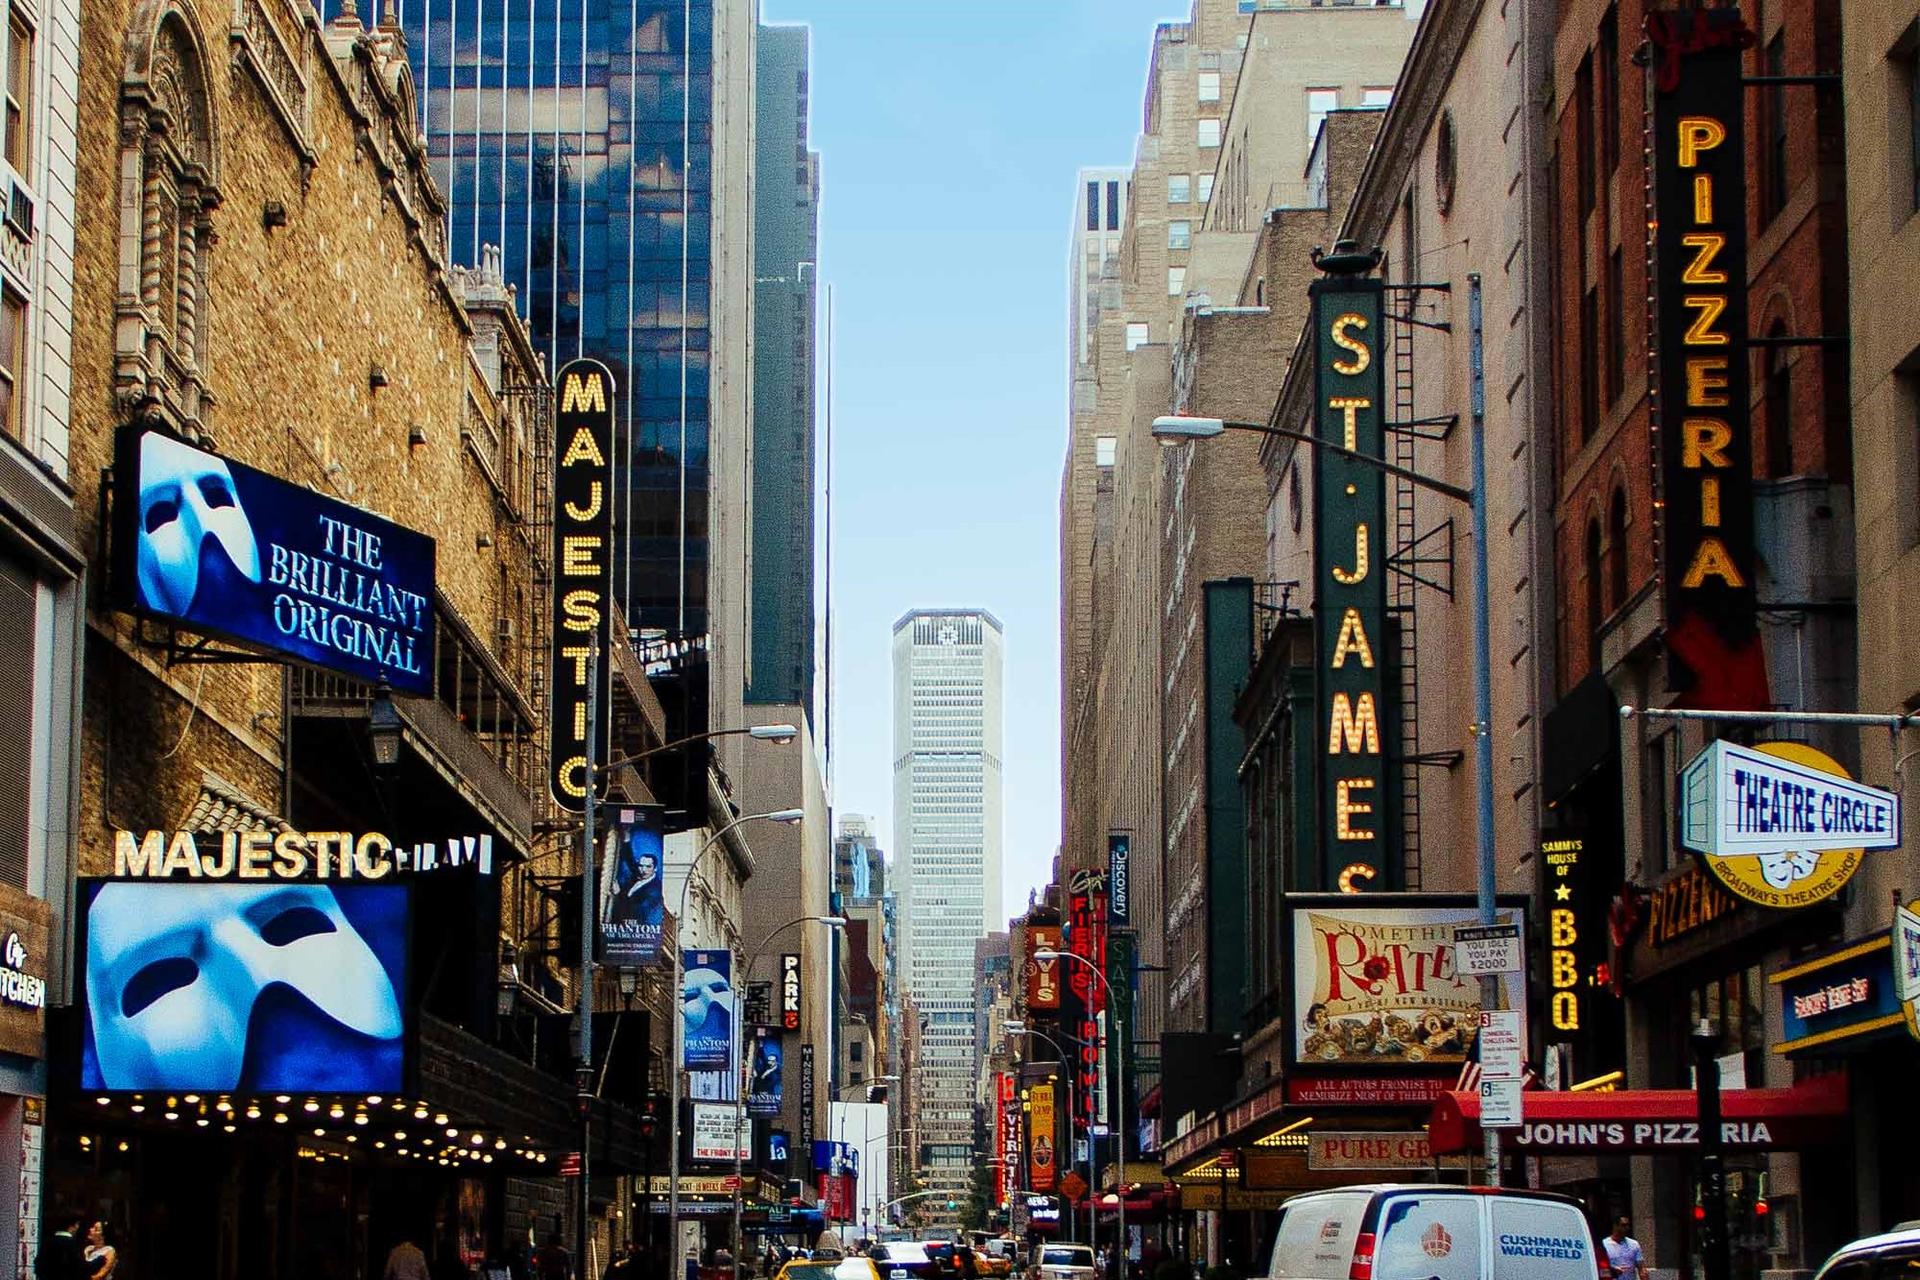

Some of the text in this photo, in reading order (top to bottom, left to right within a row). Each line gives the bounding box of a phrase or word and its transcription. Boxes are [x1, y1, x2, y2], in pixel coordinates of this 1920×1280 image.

[1677, 115, 1746, 590] PIZZERIA
[319, 513, 383, 571] THE
[269, 541, 427, 634] BRILLIANT
[558, 372, 606, 799] MAJESTIC
[273, 591, 422, 675] ORIGINAL
[1733, 768, 1886, 833] THEATRE CIRCLE
[113, 829, 393, 880] MAJESTIC
[1546, 853, 1578, 865] HOUSE
[1556, 865, 1570, 877] OF
[1713, 851, 1858, 906] BROADWAY'S THEATRE SHOP
[1113, 850, 1128, 918] Discovery
[600, 923, 661, 934] PHANTOM
[1466, 940, 1486, 950] YOU
[1467, 949, 1508, 959] YOU PAY
[1470, 958, 1508, 969] $2000
[1551, 908, 1580, 1031] BBQ
[784, 955, 799, 1011] PARK
[1481, 1013, 1490, 1027] 3
[685, 1040, 730, 1050] PHANTOM
[1315, 1080, 1443, 1090] ALL ACTORS PROMISE TO
[1482, 1083, 1491, 1096] 6
[1298, 1091, 1351, 1101] MEMORIZE
[1355, 1091, 1382, 1101] MOST
[1383, 1091, 1396, 1101] OF
[1399, 1091, 1428, 1101] THEIR
[1516, 1122, 1773, 1145] JOHN'S PIZZRIA
[697, 1148, 709, 1157] THE
[1323, 1139, 1392, 1160] PURE
[1500, 1235, 1585, 1250] CUSHMAN &
[1500, 1245, 1582, 1260] WAKEFIELD
